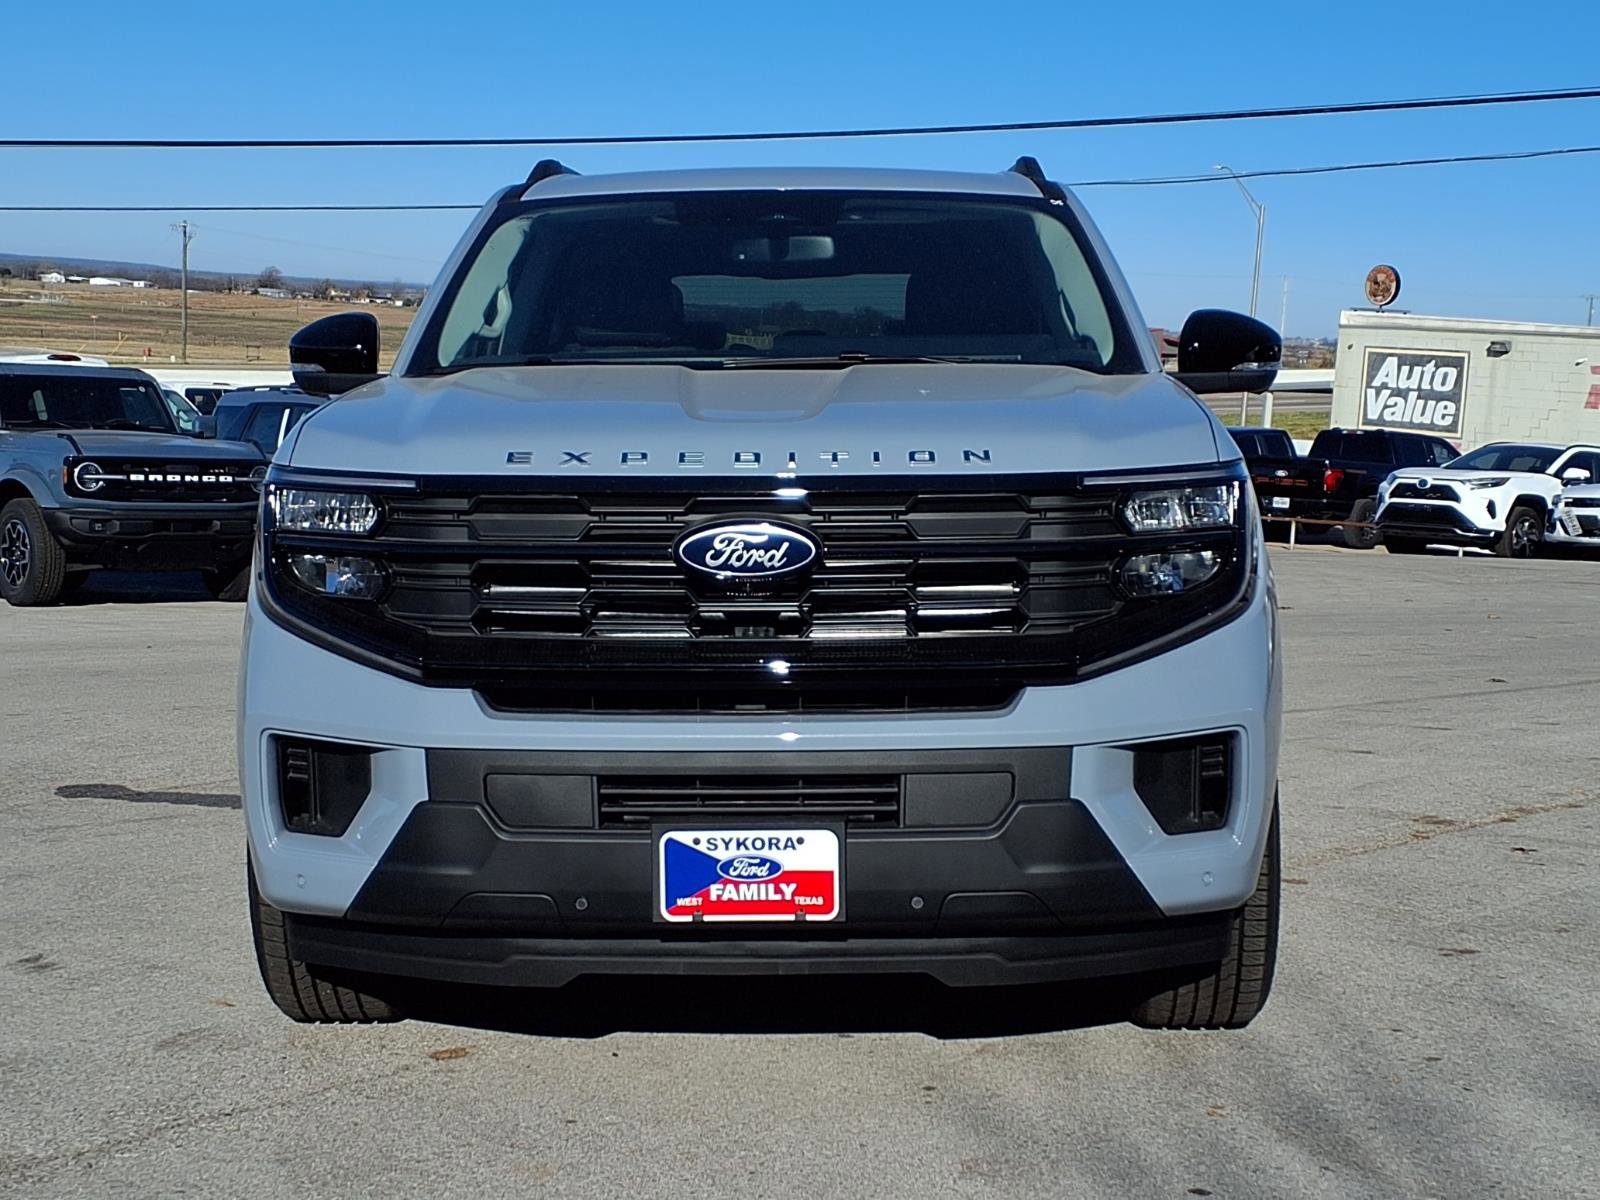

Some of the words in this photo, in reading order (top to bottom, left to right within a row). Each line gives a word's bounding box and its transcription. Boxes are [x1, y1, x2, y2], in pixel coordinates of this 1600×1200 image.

[1370, 356, 1458, 392] Auto
[1366, 388, 1457, 426] Value
[505, 449, 992, 468] EXPEDITION
[129, 474, 233, 482] BRONCO
[705, 532, 790, 569] Ford
[706, 836, 797, 851] SYKORA
[728, 857, 770, 877] Ford
[676, 897, 703, 906] WEST
[794, 896, 824, 906] TEXAS
[709, 883, 797, 901] FAMILY
